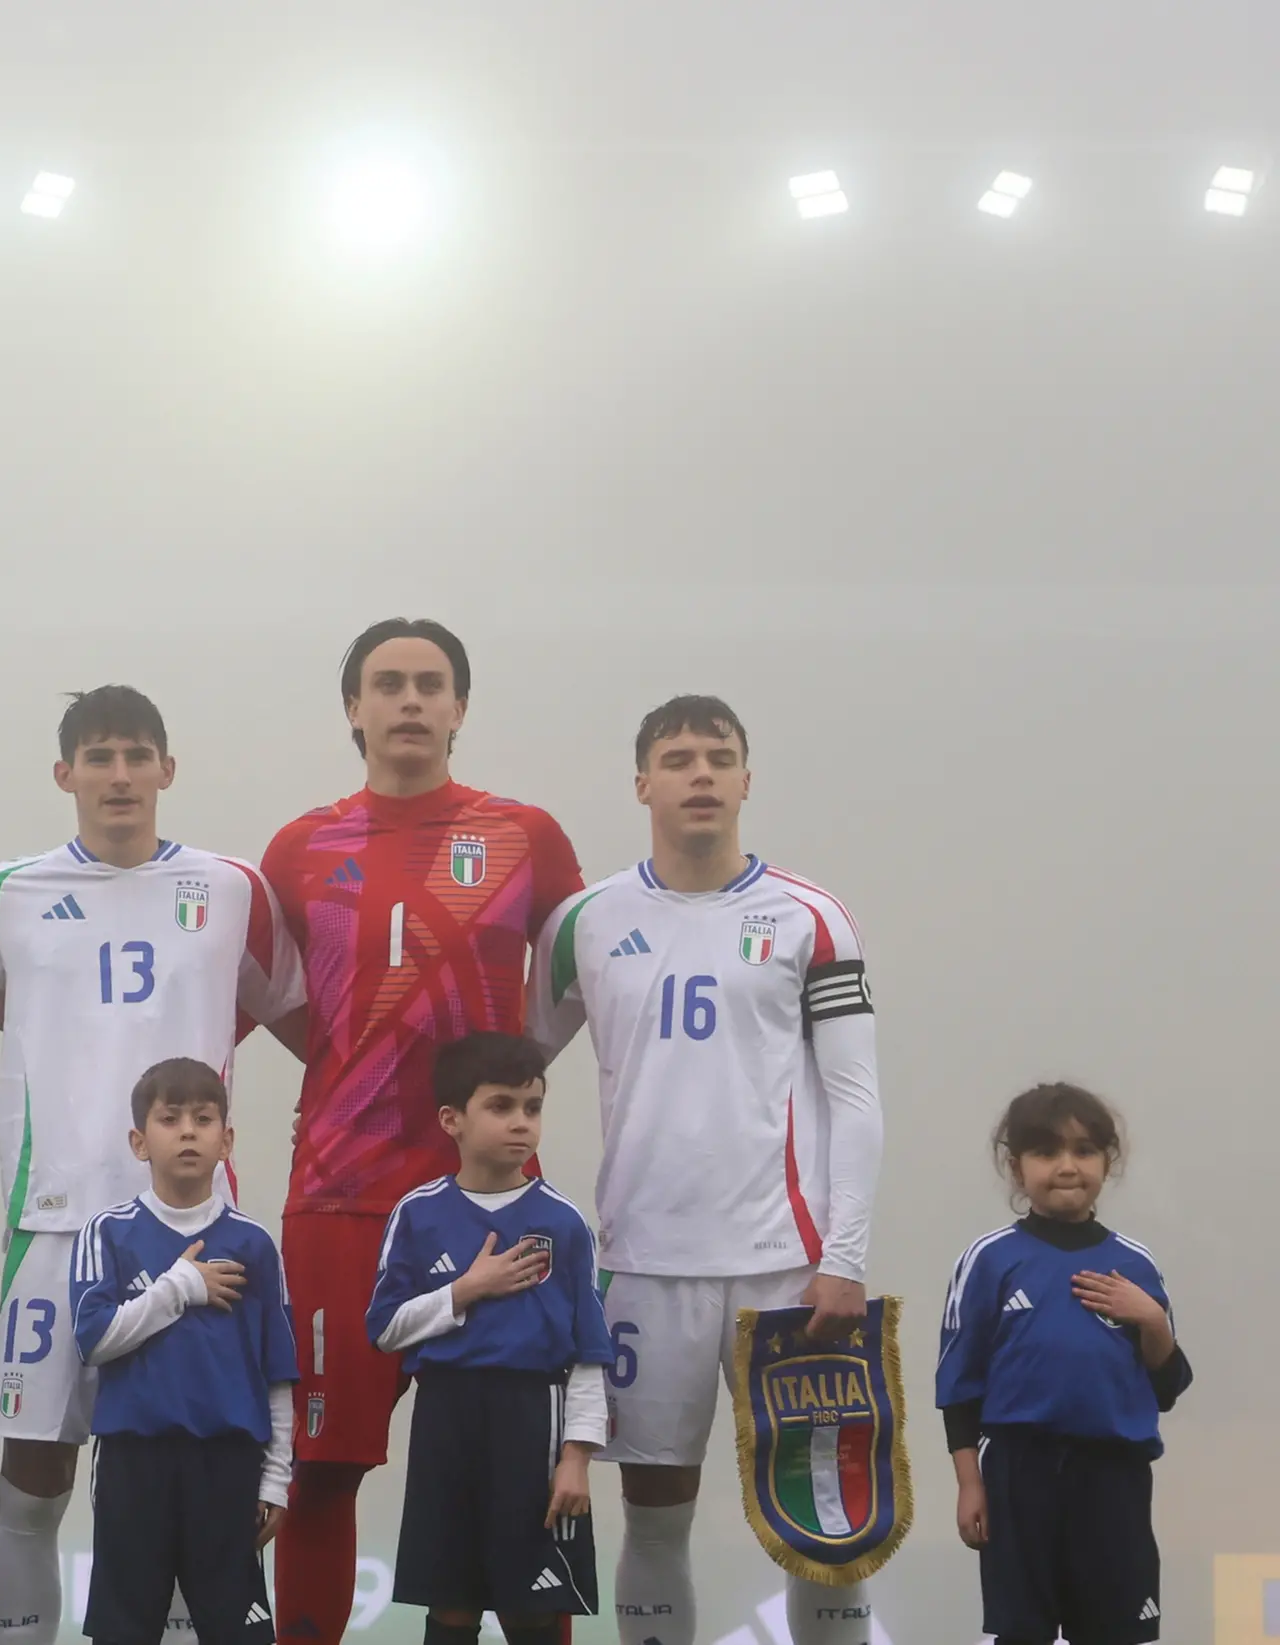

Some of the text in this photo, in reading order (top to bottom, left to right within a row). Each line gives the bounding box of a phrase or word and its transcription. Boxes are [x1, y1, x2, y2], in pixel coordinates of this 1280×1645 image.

[453, 844, 483, 856] ITALIA
[178, 890, 206, 902] ITALIA
[389, 901, 404, 967] 1
[744, 925, 773, 936] ITALIA
[99, 941, 155, 1004] 13
[659, 974, 718, 1041] 16
[3, 1298, 56, 1364] 13
[312, 1308, 325, 1377] 1
[772, 1371, 867, 1410] ITALIA
[812, 1410, 839, 1425] FIGC
